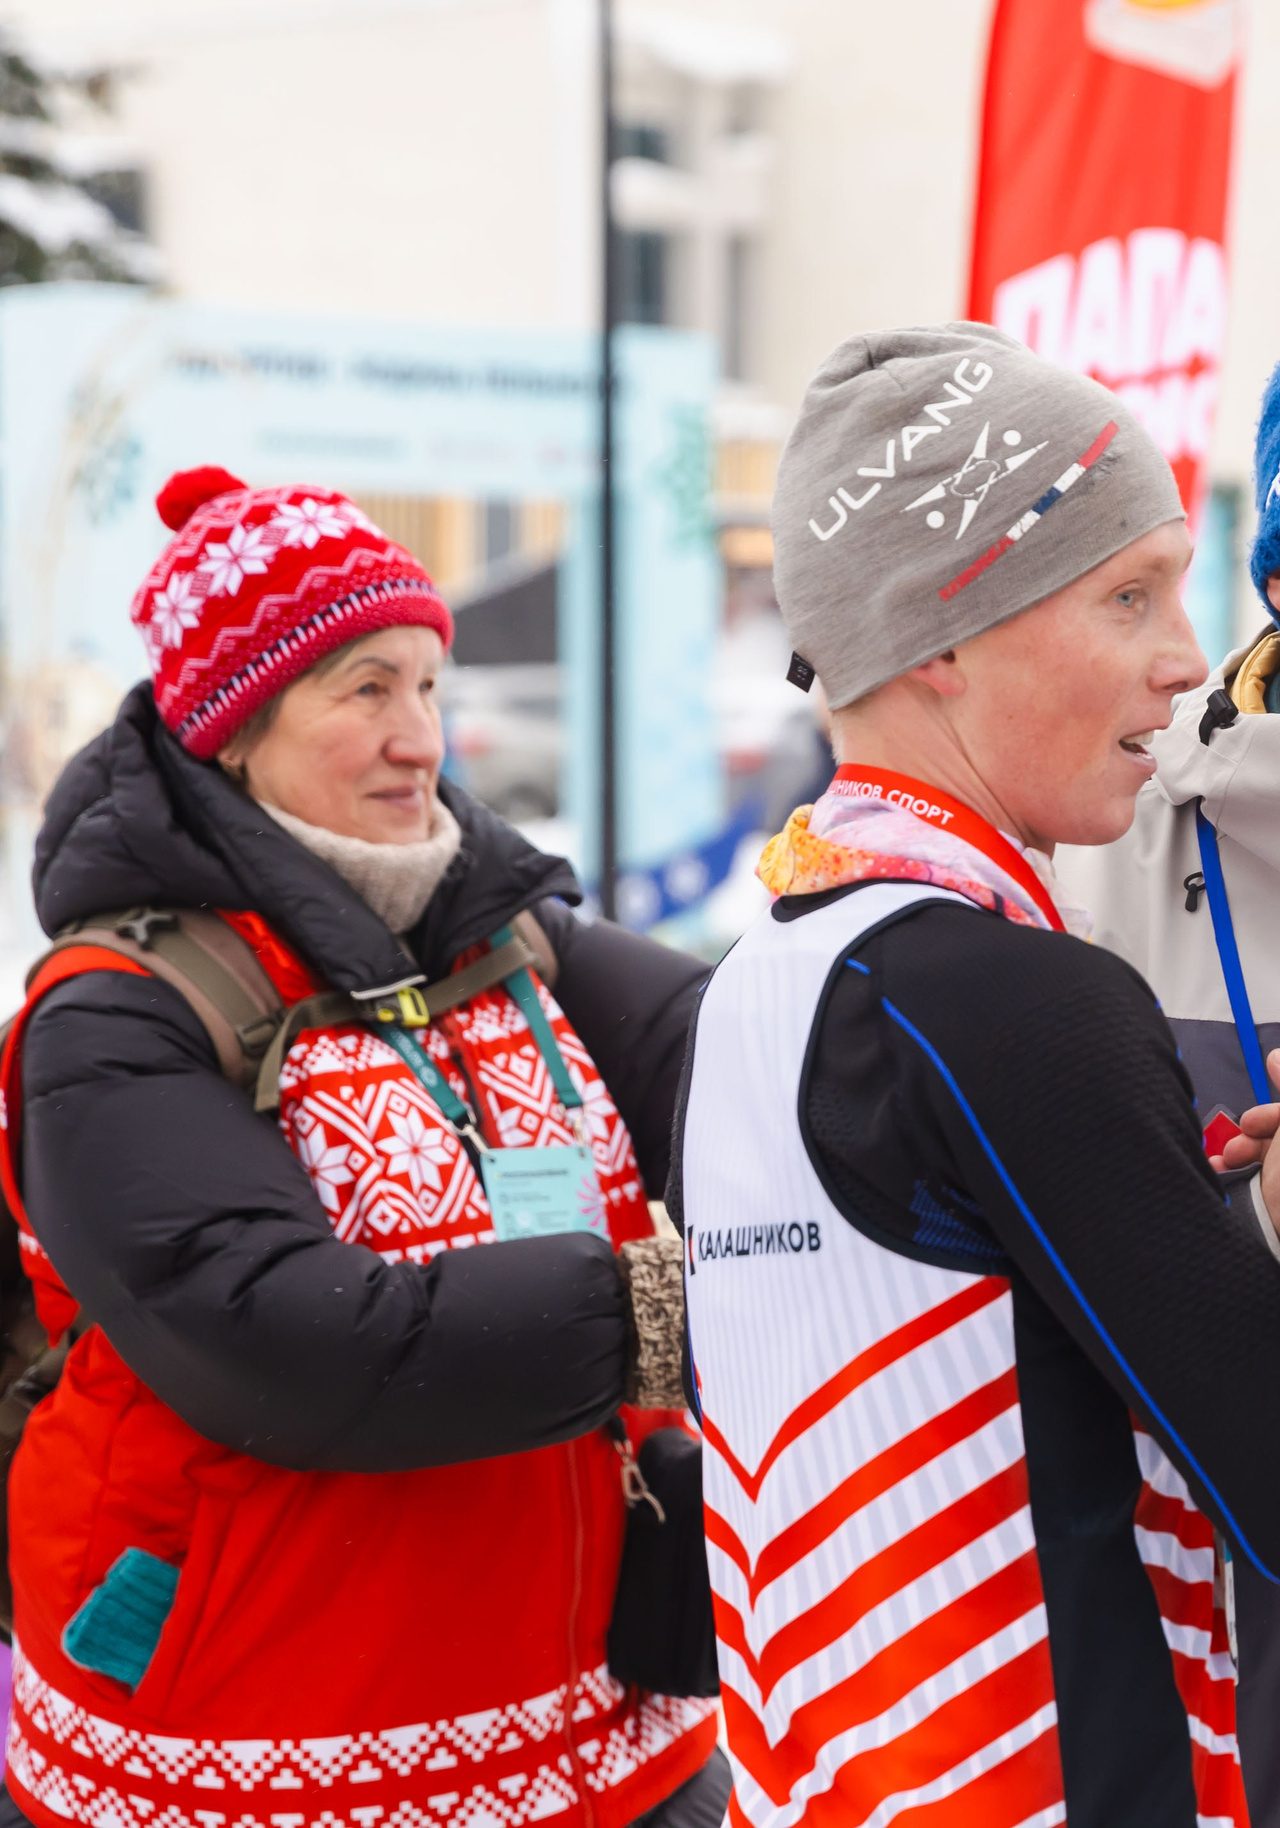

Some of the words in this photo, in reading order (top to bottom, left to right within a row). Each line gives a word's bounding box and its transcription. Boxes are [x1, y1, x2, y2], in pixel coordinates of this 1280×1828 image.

[808, 357, 994, 541] ULVANG
[886, 789, 954, 825] СПОРТ
[698, 1221, 822, 1262] КАЛАШНИКОВ
